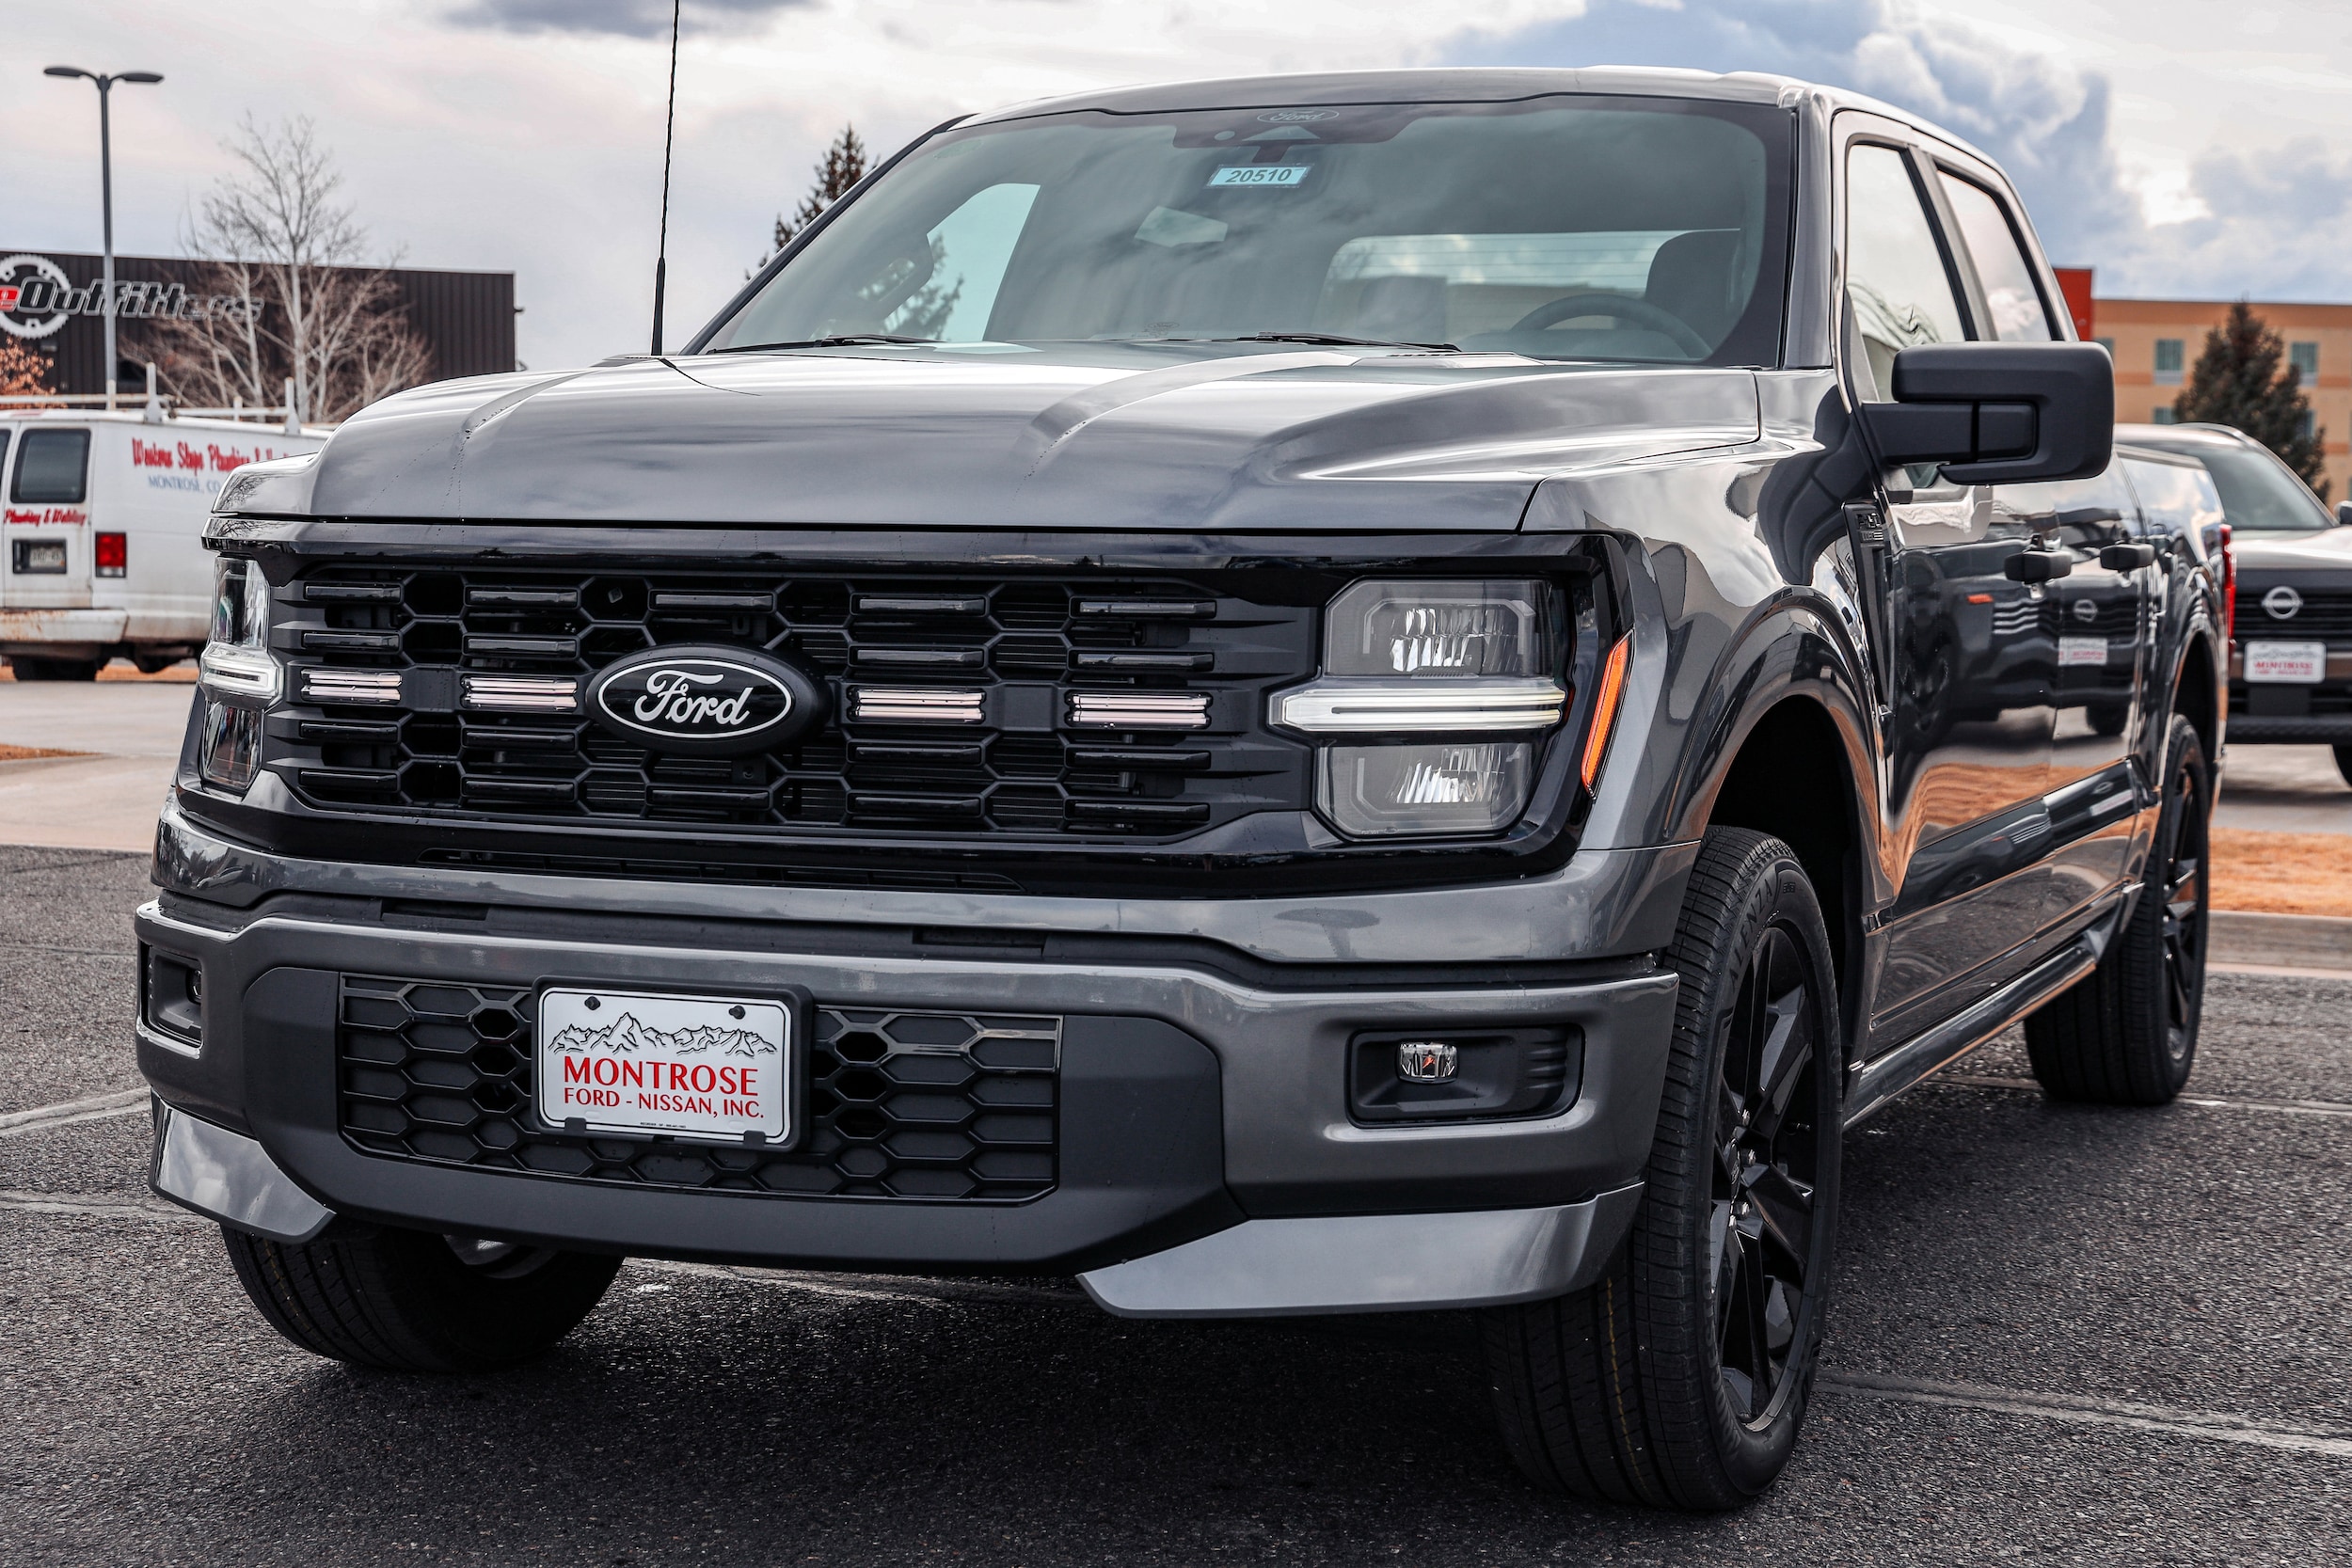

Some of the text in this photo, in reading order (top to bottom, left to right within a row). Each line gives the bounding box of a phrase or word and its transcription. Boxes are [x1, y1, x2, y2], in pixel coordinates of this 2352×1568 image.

[1270, 109, 1326, 121] Ford
[1225, 168, 1293, 183] 20510
[634, 669, 754, 726] Ford
[1729, 878, 1773, 994] ALENZA
[564, 1055, 758, 1097] MONTROSE
[564, 1087, 620, 1107] FORD
[638, 1093, 718, 1118] NISSAN,
[723, 1099, 765, 1119] INC.
